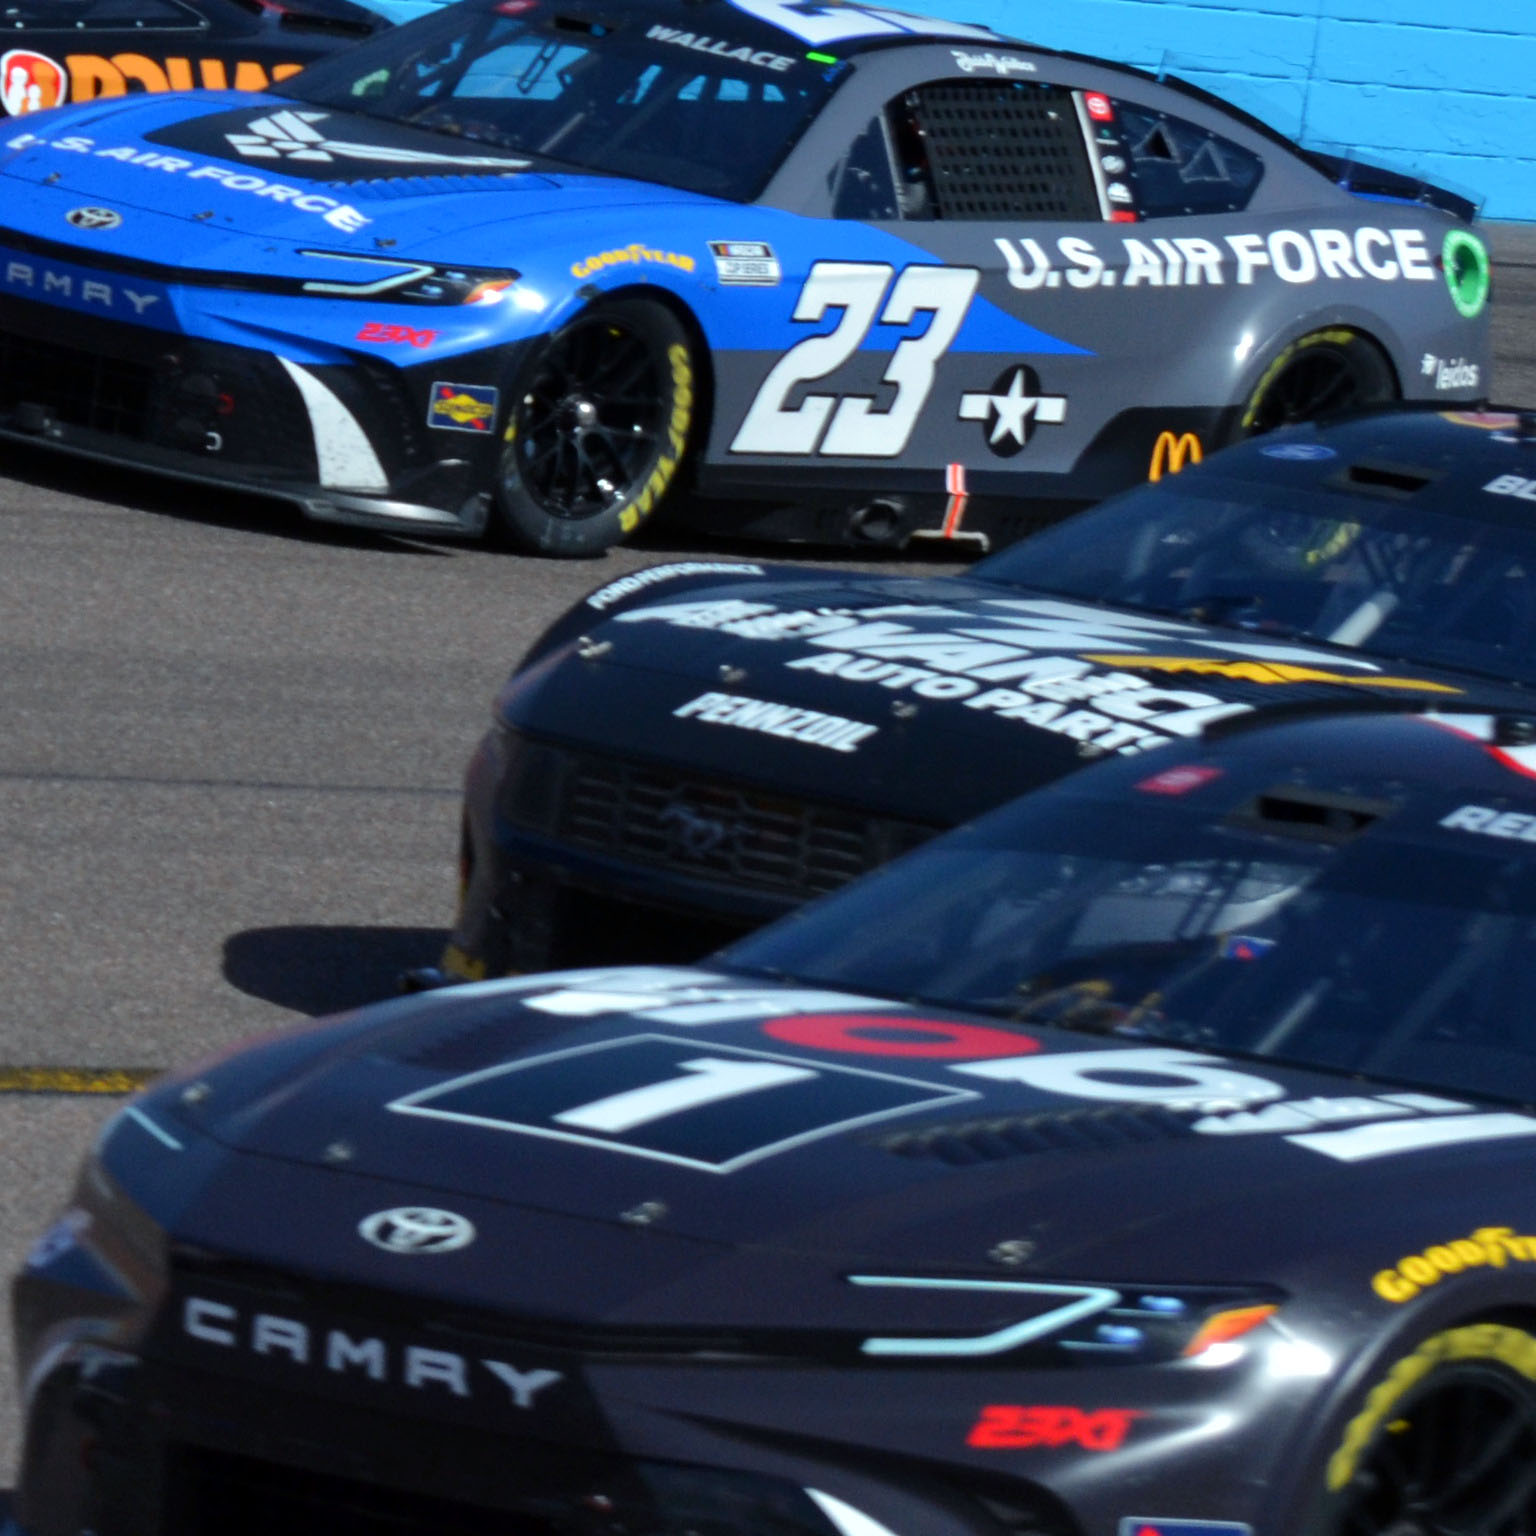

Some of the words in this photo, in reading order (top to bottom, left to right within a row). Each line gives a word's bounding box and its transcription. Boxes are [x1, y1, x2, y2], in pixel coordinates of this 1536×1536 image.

[646, 24, 796, 72] WALLACE
[94, 145, 188, 174] AIR
[185, 164, 374, 234] FORCE
[571, 243, 697, 279] GOODYEAR
[994, 236, 1116, 290] U.S.
[1126, 237, 1227, 287] AIR
[1230, 226, 1438, 286] FORCE
[730, 260, 980, 457] 23
[784, 652, 979, 700] AUTO
[671, 691, 881, 754] PENNZOIL
[183, 1297, 565, 1409] CAMRY
